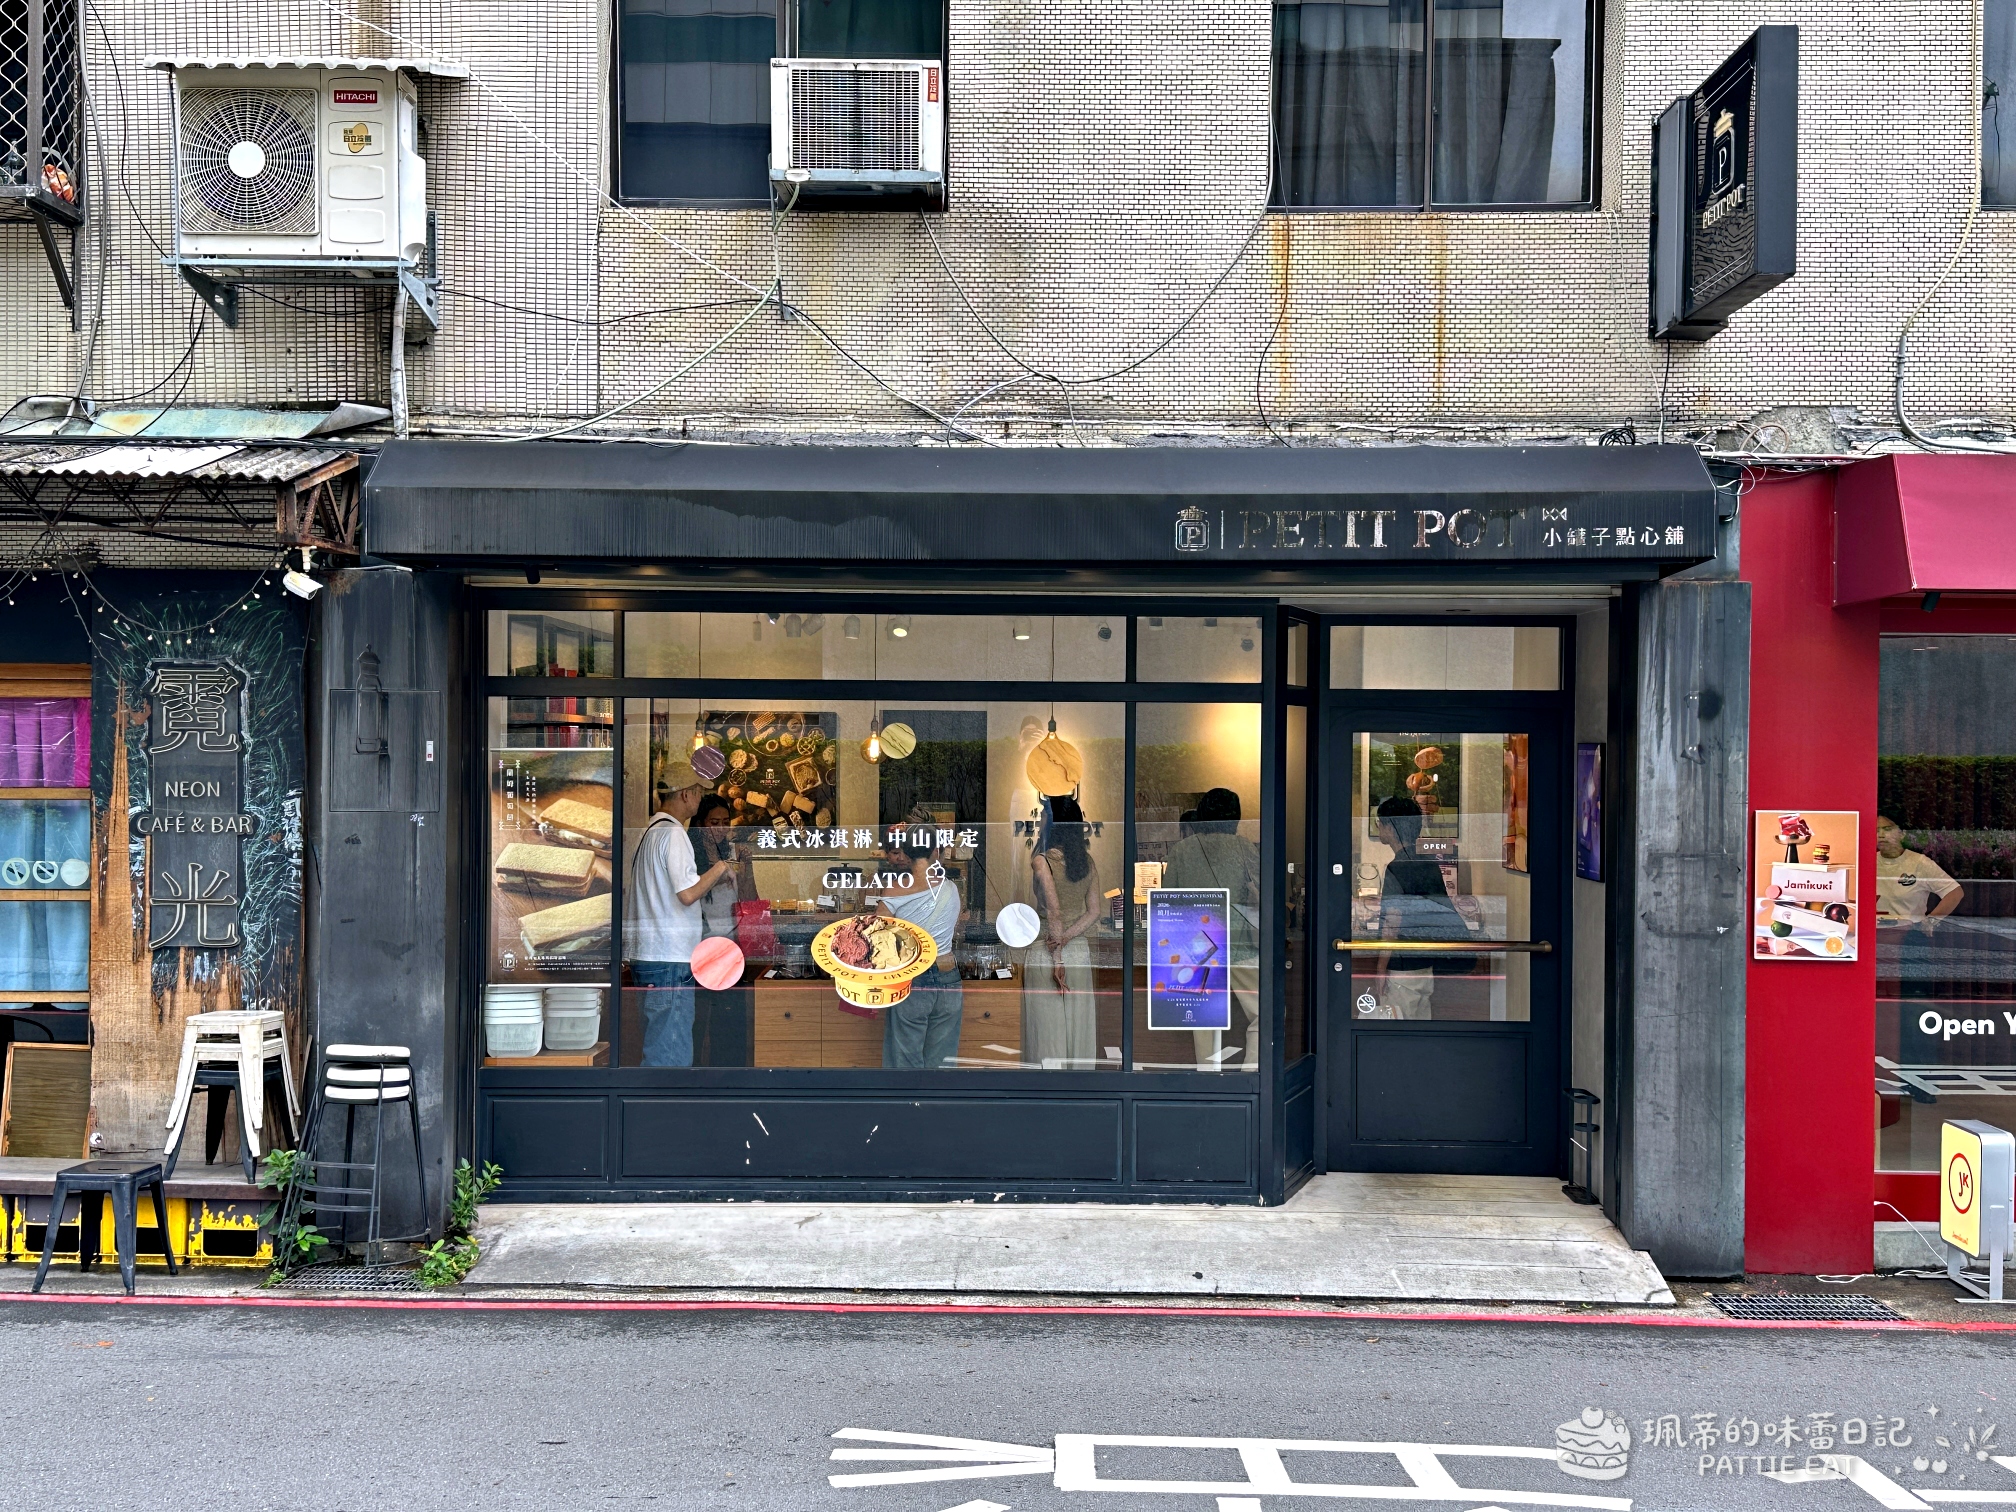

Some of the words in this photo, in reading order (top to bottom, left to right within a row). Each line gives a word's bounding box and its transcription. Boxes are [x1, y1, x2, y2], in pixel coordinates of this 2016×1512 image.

[336, 93, 376, 101] HITACHI
[1718, 146, 1728, 185] P
[1702, 197, 1727, 229] PETIT
[1726, 183, 1746, 211] POT
[1238, 510, 1396, 548] PETIT
[1412, 508, 1527, 549] POT
[165, 781, 220, 798] NEON
[136, 812, 186, 833] CAFÉ
[190, 816, 205, 833] &
[211, 816, 253, 833] BAR
[822, 872, 915, 889] GELATO
[149, 862, 240, 949] 光
[818, 943, 833, 966] PETIT
[833, 967, 859, 979] POT
[871, 995, 880, 1004] P
[1918, 1010, 1995, 1041] Open
